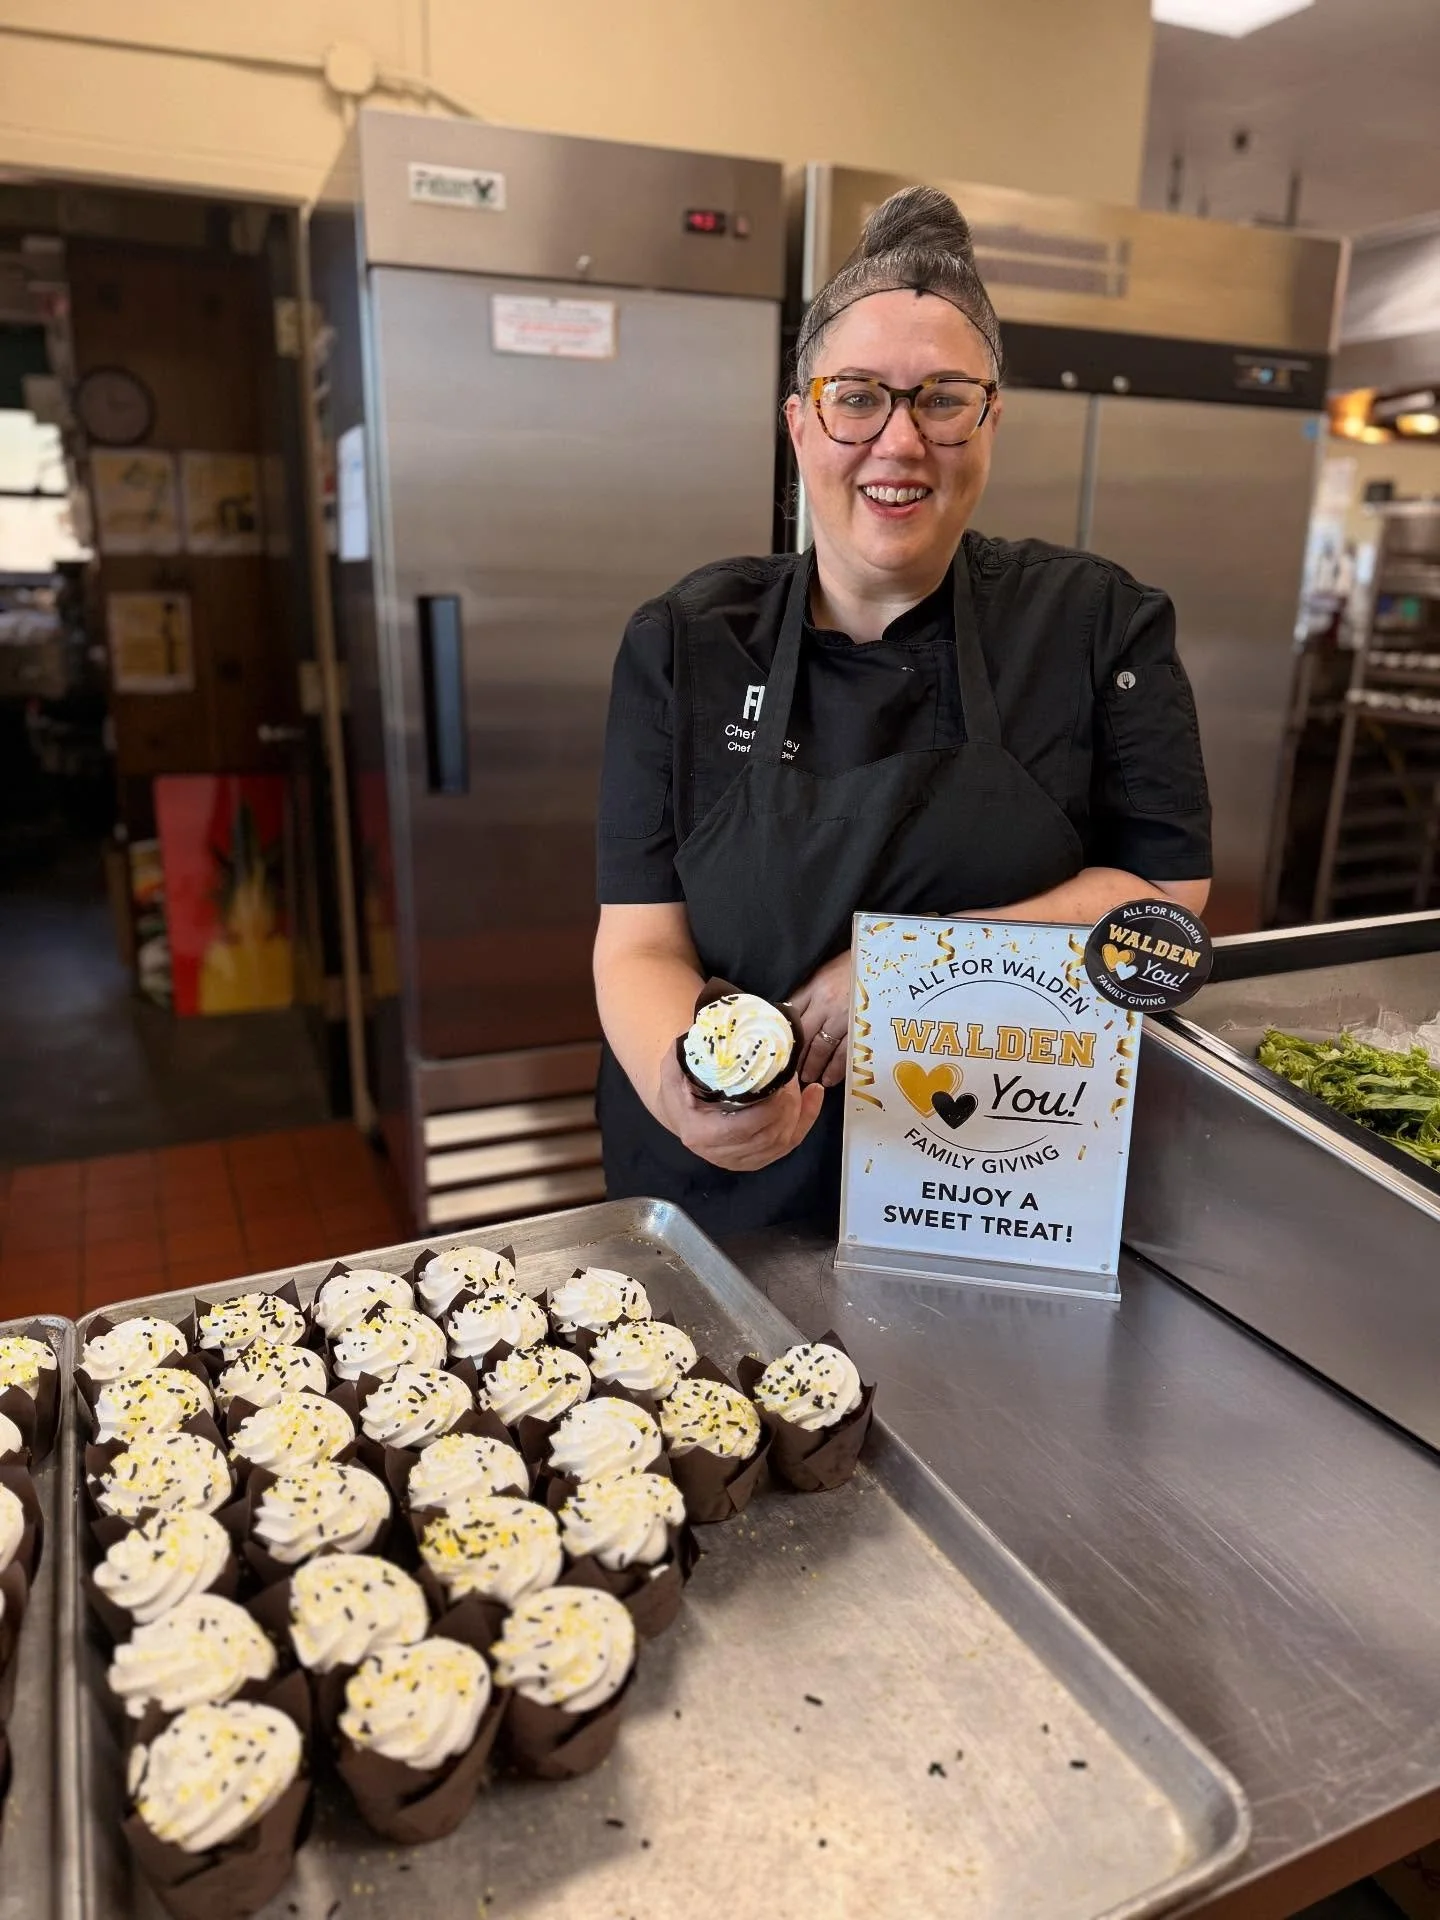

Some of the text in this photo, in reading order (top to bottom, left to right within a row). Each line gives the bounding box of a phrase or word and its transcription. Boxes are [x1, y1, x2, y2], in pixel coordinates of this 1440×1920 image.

[725, 724, 757, 740] Chef
[727, 741, 752, 753] Chef
[1123, 905, 1204, 944] ALL FOR WALDEN
[1108, 923, 1201, 968] WALDEN
[908, 958, 1090, 1016] ALL FOR WALDEN
[1096, 974, 1167, 1006] FAMILY GIVING
[1142, 959, 1191, 988] You!
[891, 1017, 1097, 1068] WALDEN
[990, 1073, 1088, 1118] You!
[904, 1127, 1060, 1174] FAMILY GIVING
[922, 1181, 1039, 1211] ENJOY A
[883, 1205, 1073, 1243] SWEET TREAT!
